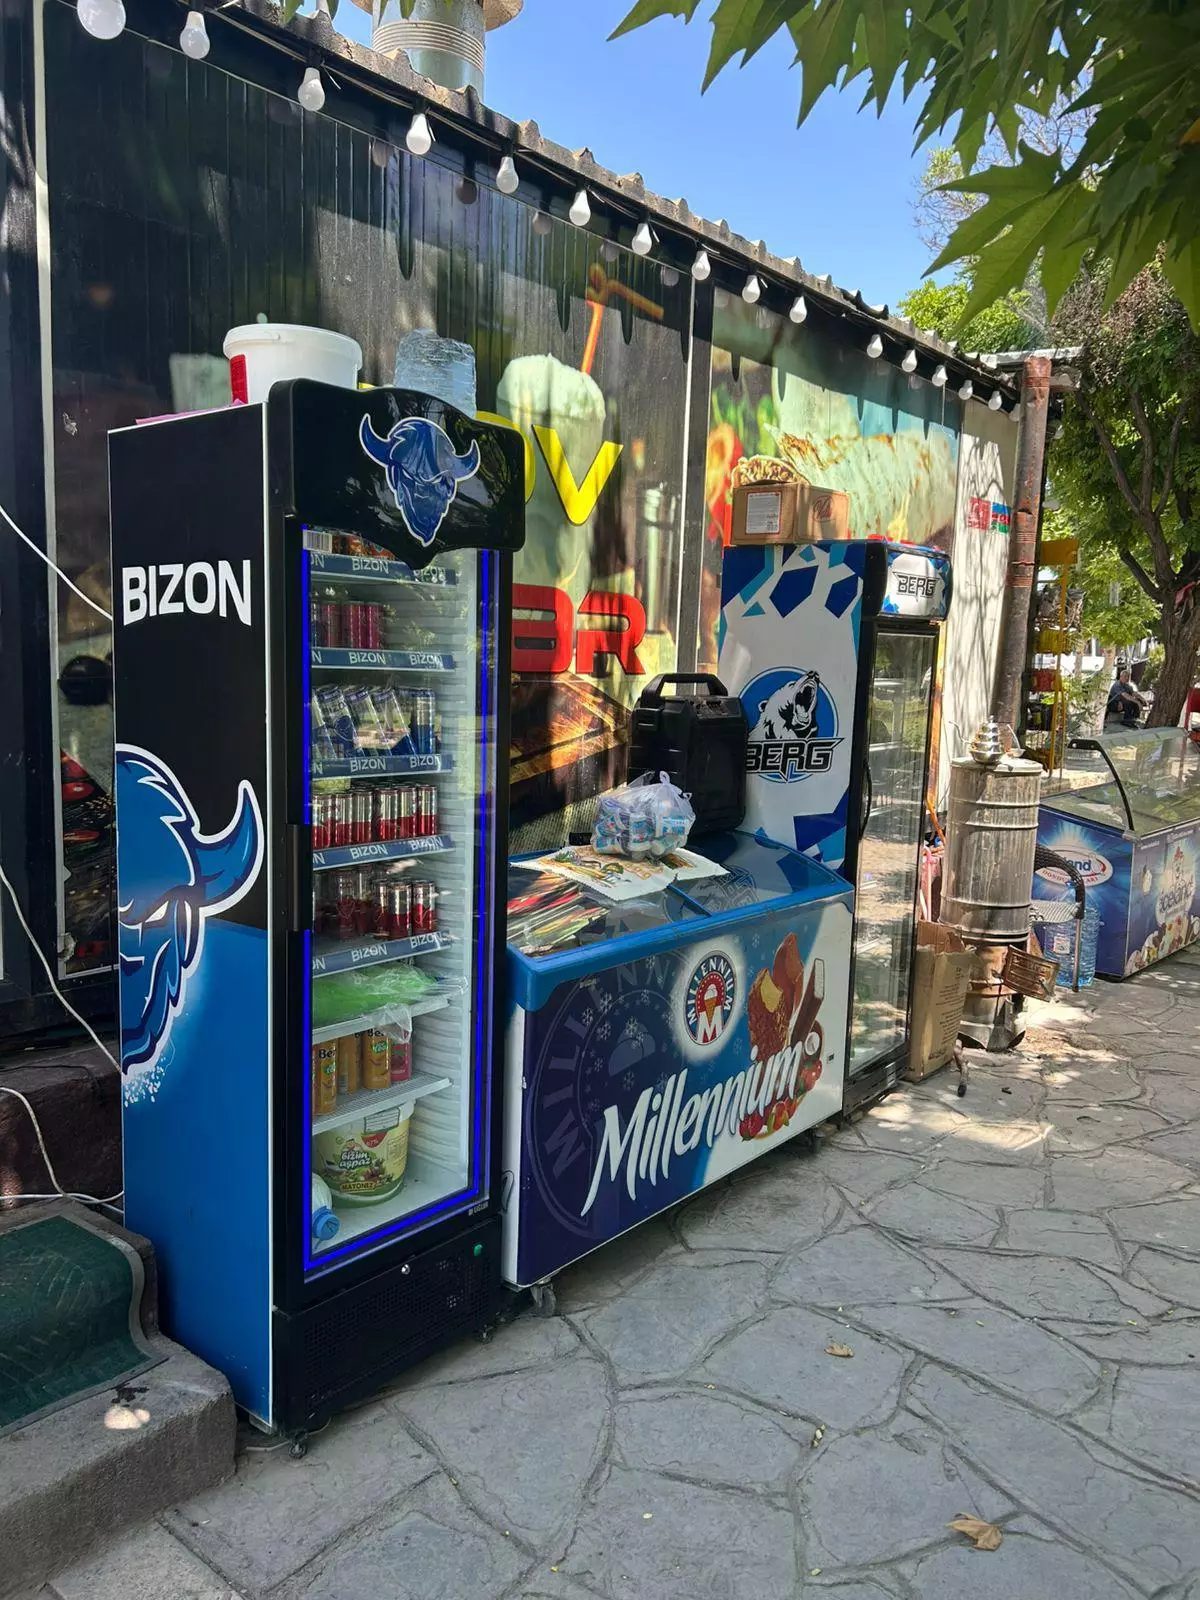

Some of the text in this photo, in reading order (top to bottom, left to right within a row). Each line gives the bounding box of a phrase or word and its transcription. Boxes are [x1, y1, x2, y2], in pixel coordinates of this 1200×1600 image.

[352, 556, 390, 575] BIZON
[122, 559, 252, 627] BIZON
[895, 573, 940, 602] BERG
[349, 651, 387, 665] BIZON
[409, 653, 444, 667] BIZON
[350, 758, 387, 773] BIZON
[410, 754, 442, 769] BIZON
[746, 738, 845, 784] BERG
[350, 843, 389, 860] BIZON
[351, 943, 388, 962] BIZON
[686, 956, 735, 1025] MILLENNIUM
[580, 1039, 804, 1217] Millennium
